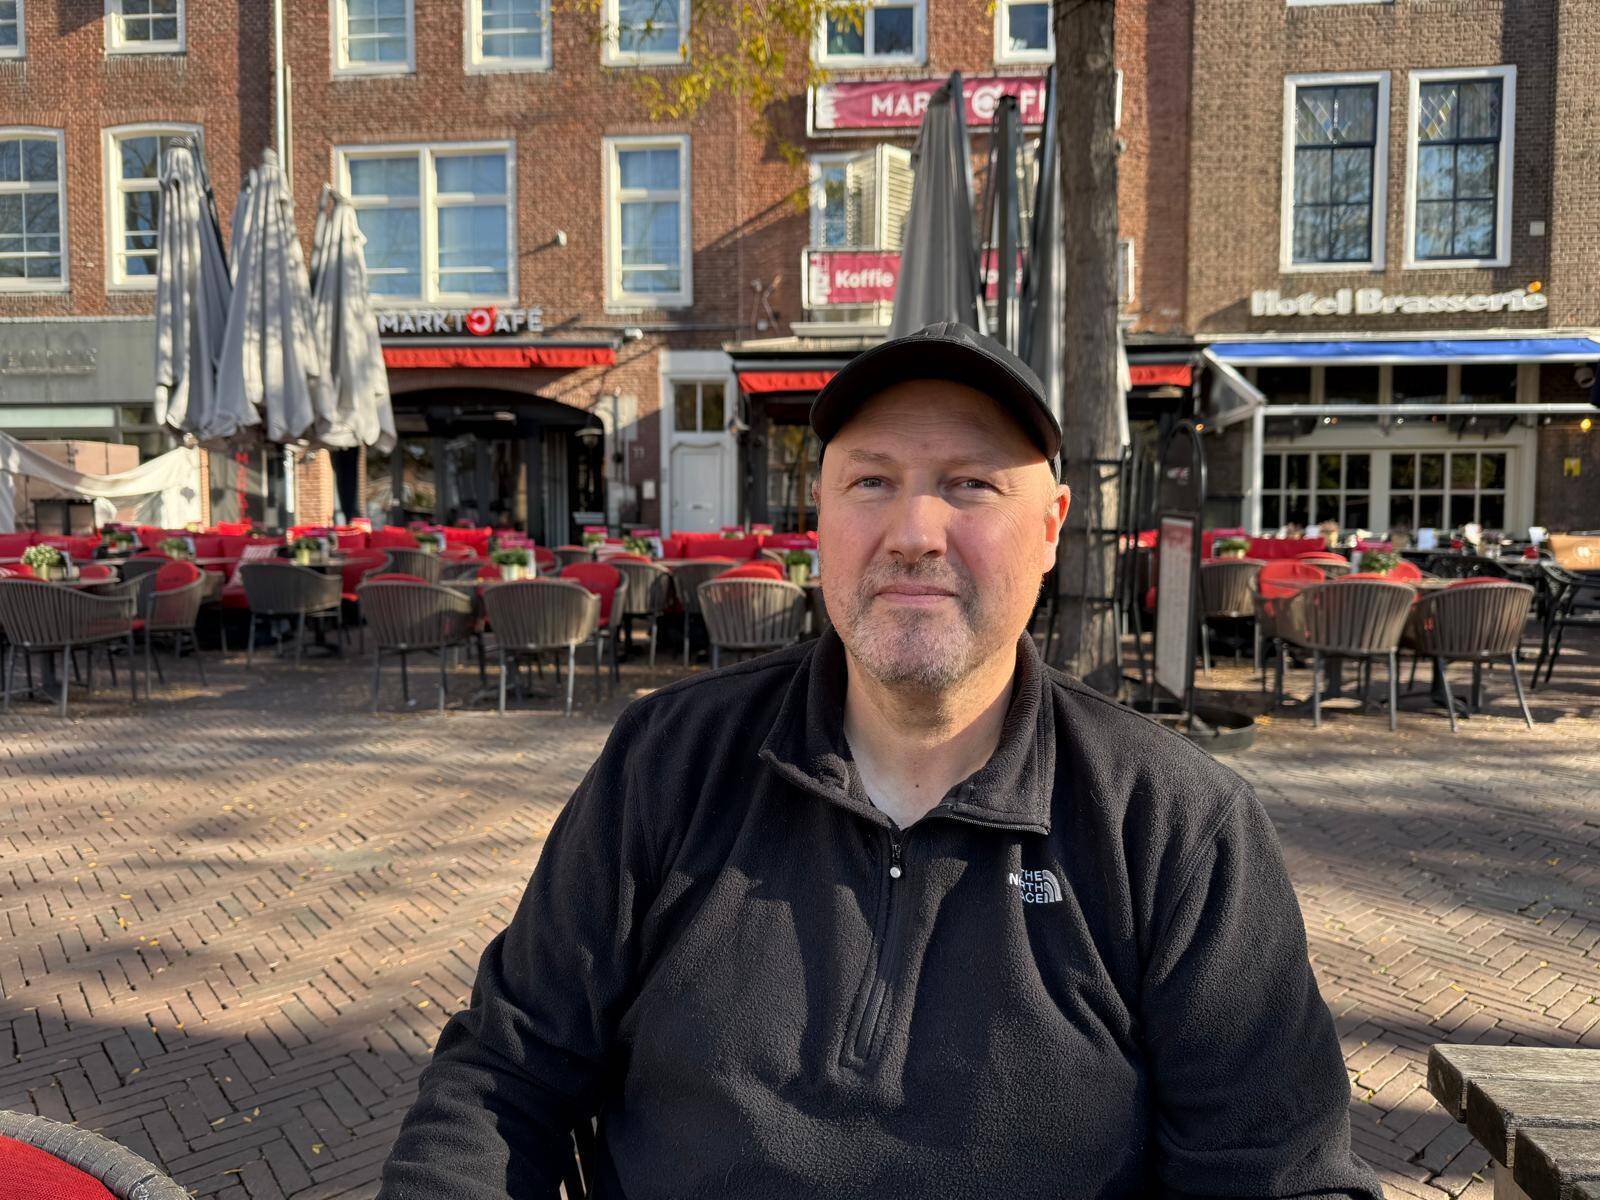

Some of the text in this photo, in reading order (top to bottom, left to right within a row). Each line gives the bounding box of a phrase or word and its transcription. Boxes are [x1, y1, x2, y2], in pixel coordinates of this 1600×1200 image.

[835, 268, 895, 289] Koffie
[1251, 288, 1352, 317] Hotel
[1009, 872, 1044, 893] NRTH
[1020, 868, 1043, 882] HE
